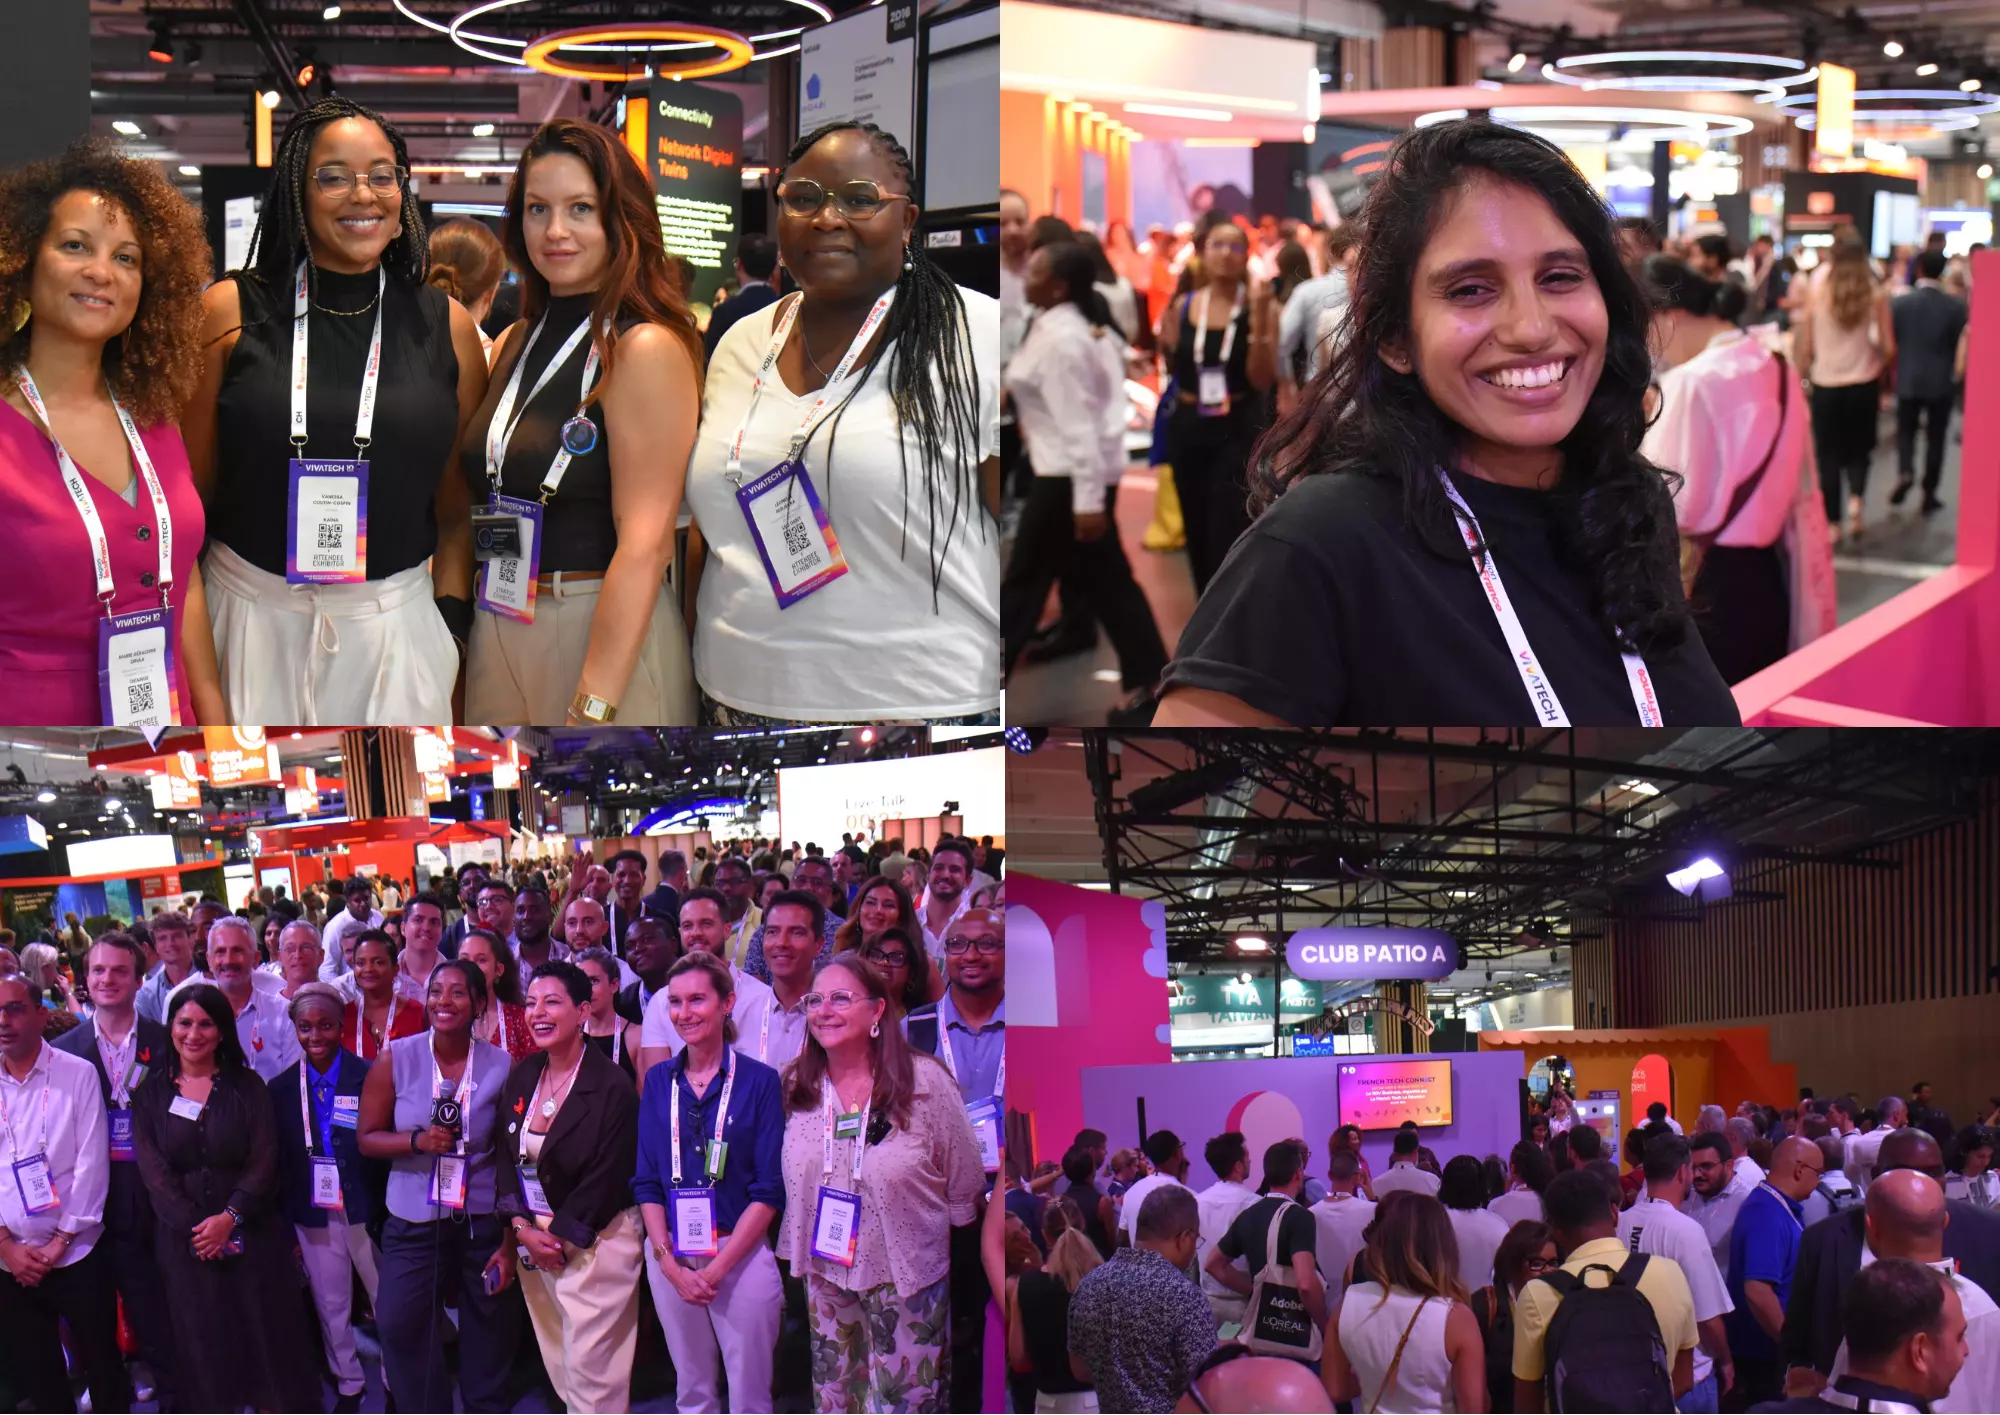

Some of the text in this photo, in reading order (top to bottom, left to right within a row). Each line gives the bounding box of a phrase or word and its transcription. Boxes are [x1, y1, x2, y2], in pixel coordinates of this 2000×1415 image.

[659, 100, 713, 129] Connectivity
[658, 136, 734, 168] Network Digital
[658, 158, 689, 180] Twins
[305, 464, 345, 472] VIVATECH
[747, 470, 782, 495] VIVATECH
[69, 477, 92, 516] VIVATECH
[161, 517, 170, 559] VIVATECH
[792, 551, 818, 570] ATTENDEE
[792, 556, 822, 577] EXHIBITOR
[115, 615, 152, 628] VIVATECH
[1519, 650, 1558, 722] VIVATECH
[1301, 944, 1446, 963] CLUB PATIO A
[444, 1107, 455, 1119] V
[1270, 1296, 1304, 1311] Adobe
[1262, 1316, 1305, 1332] L'ORÉAL
